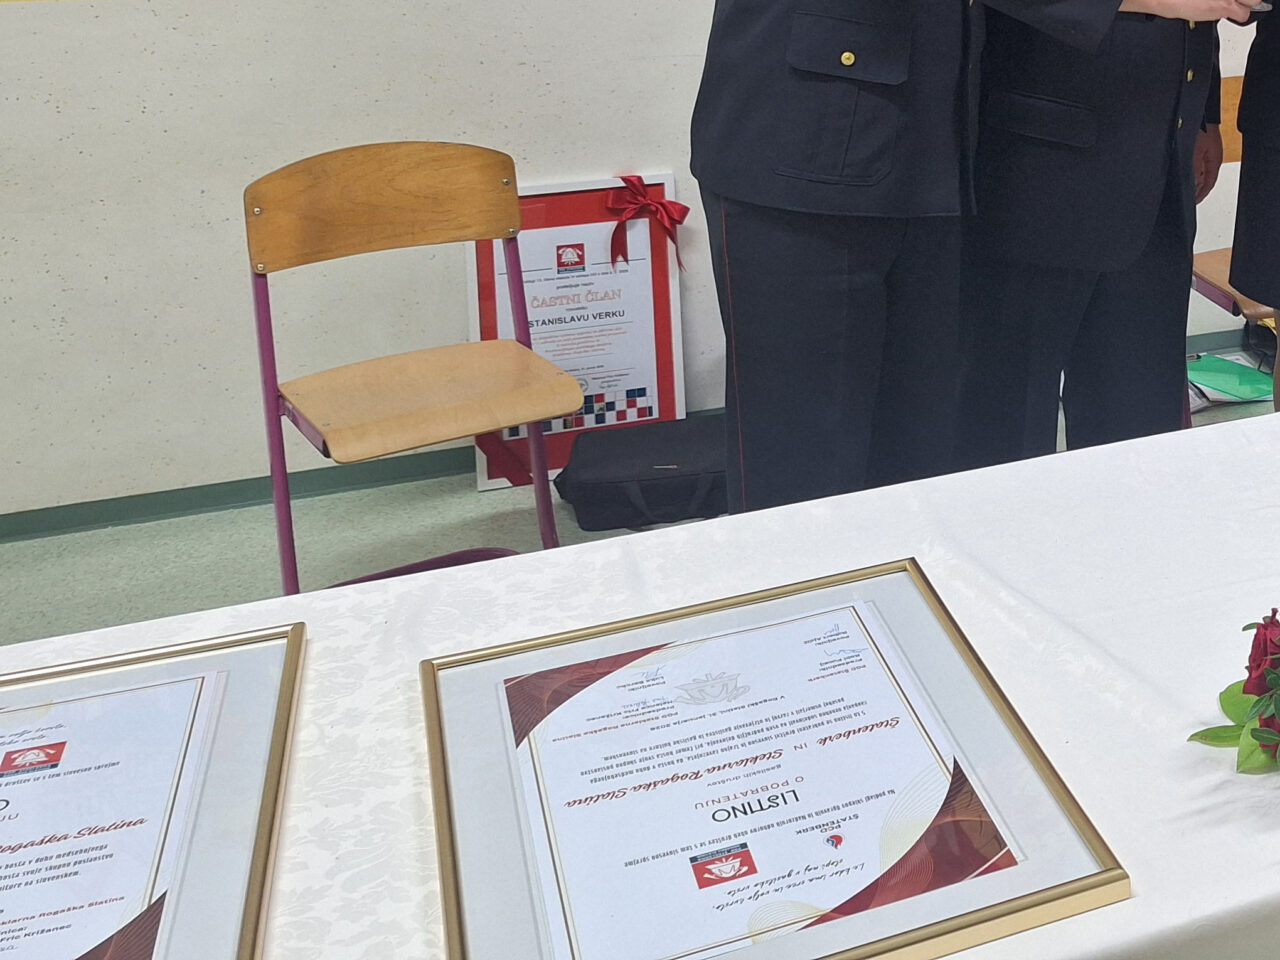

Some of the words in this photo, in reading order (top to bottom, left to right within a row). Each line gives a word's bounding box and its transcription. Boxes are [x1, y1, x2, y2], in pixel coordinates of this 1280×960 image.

[531, 294, 581, 308] ČASTNI
[585, 289, 621, 303] ČLAN
[528, 314, 589, 328] STANISLAVU
[591, 310, 625, 320] VERKU
[817, 716, 900, 746] Štatenberk
[793, 742, 808, 751] IN
[705, 748, 783, 774] Steklarna
[631, 770, 703, 792] Rogaška
[794, 775, 804, 783] O
[564, 787, 628, 808] Slatina
[694, 780, 789, 810] POBRATENJU
[711, 789, 799, 822] LISTINO
[0, 834, 73, 854] ogaška
[73, 817, 149, 839] Slatina
